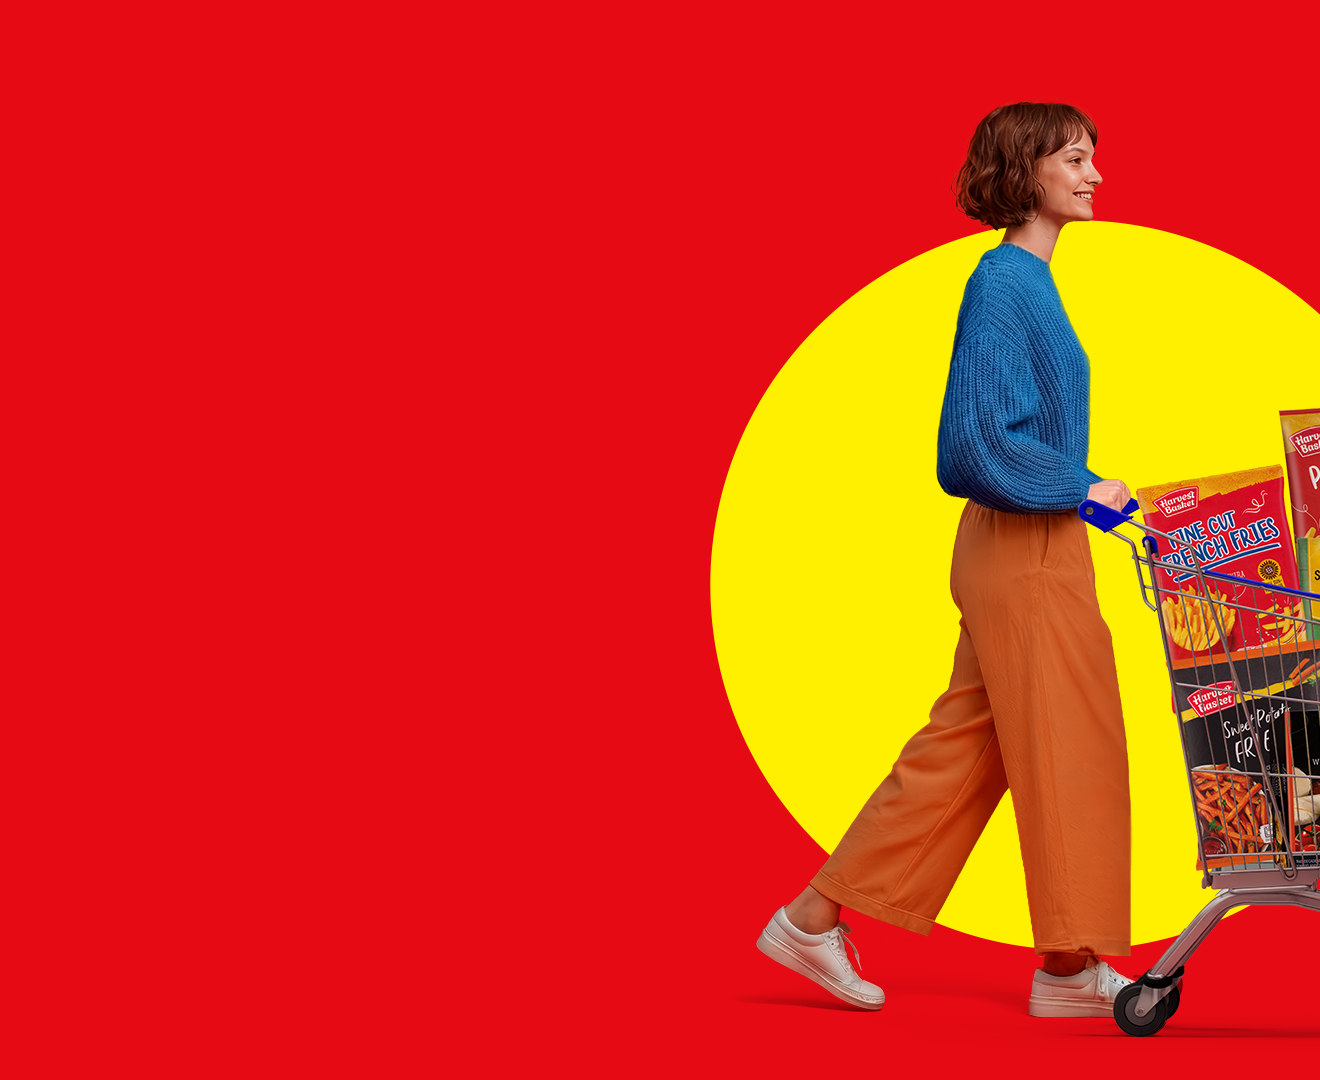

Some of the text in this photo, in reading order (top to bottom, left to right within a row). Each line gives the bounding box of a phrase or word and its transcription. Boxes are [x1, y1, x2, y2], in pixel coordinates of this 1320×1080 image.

[1159, 490, 1195, 507] Harvest
[1165, 500, 1195, 514] Basket
[1167, 510, 1235, 550] FINE CUT
[1229, 517, 1281, 552] FRIES
